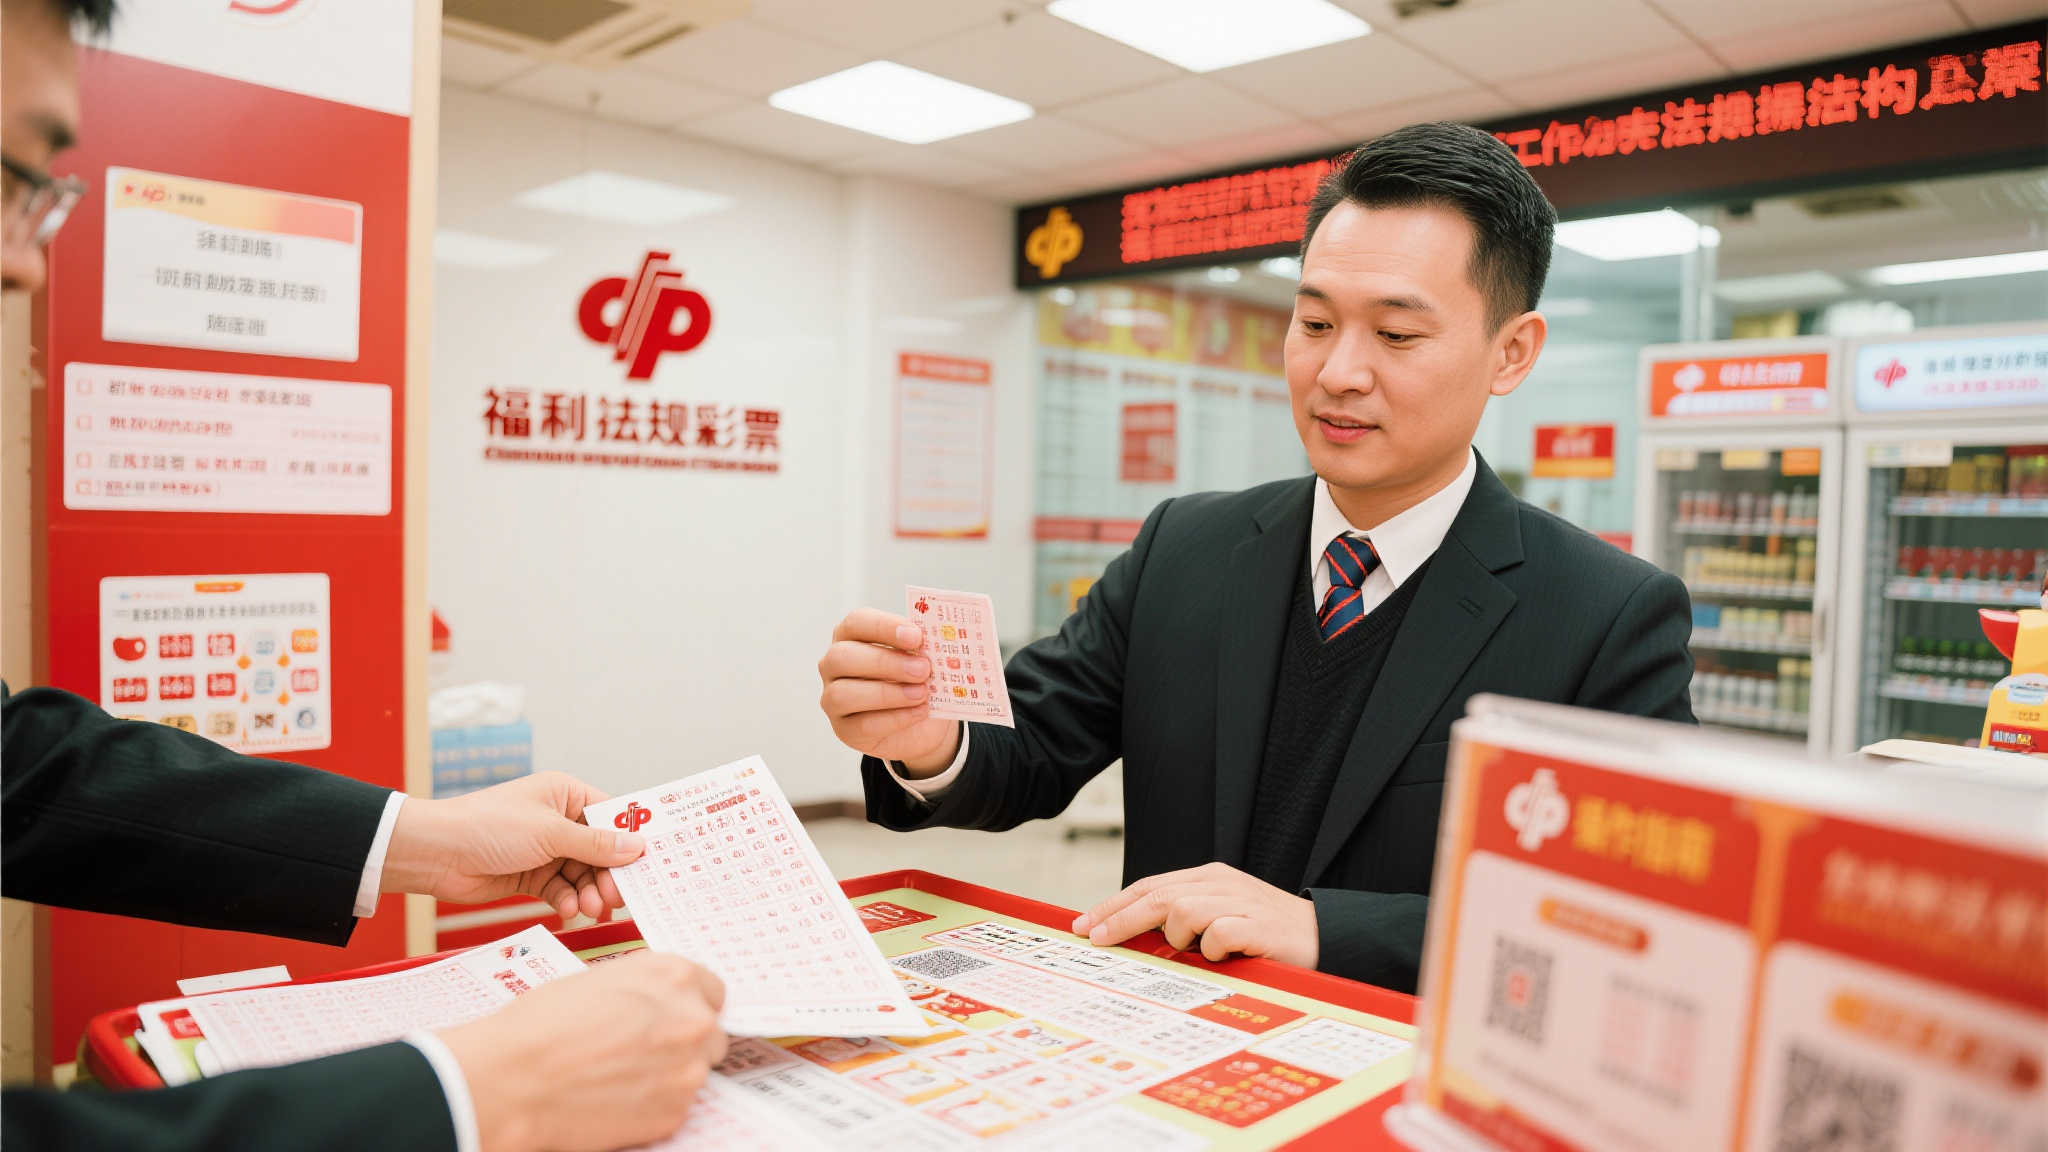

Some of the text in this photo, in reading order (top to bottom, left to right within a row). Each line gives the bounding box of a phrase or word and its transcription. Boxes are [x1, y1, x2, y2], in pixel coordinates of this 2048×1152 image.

[483, 388, 780, 452] 福利法规彩票
